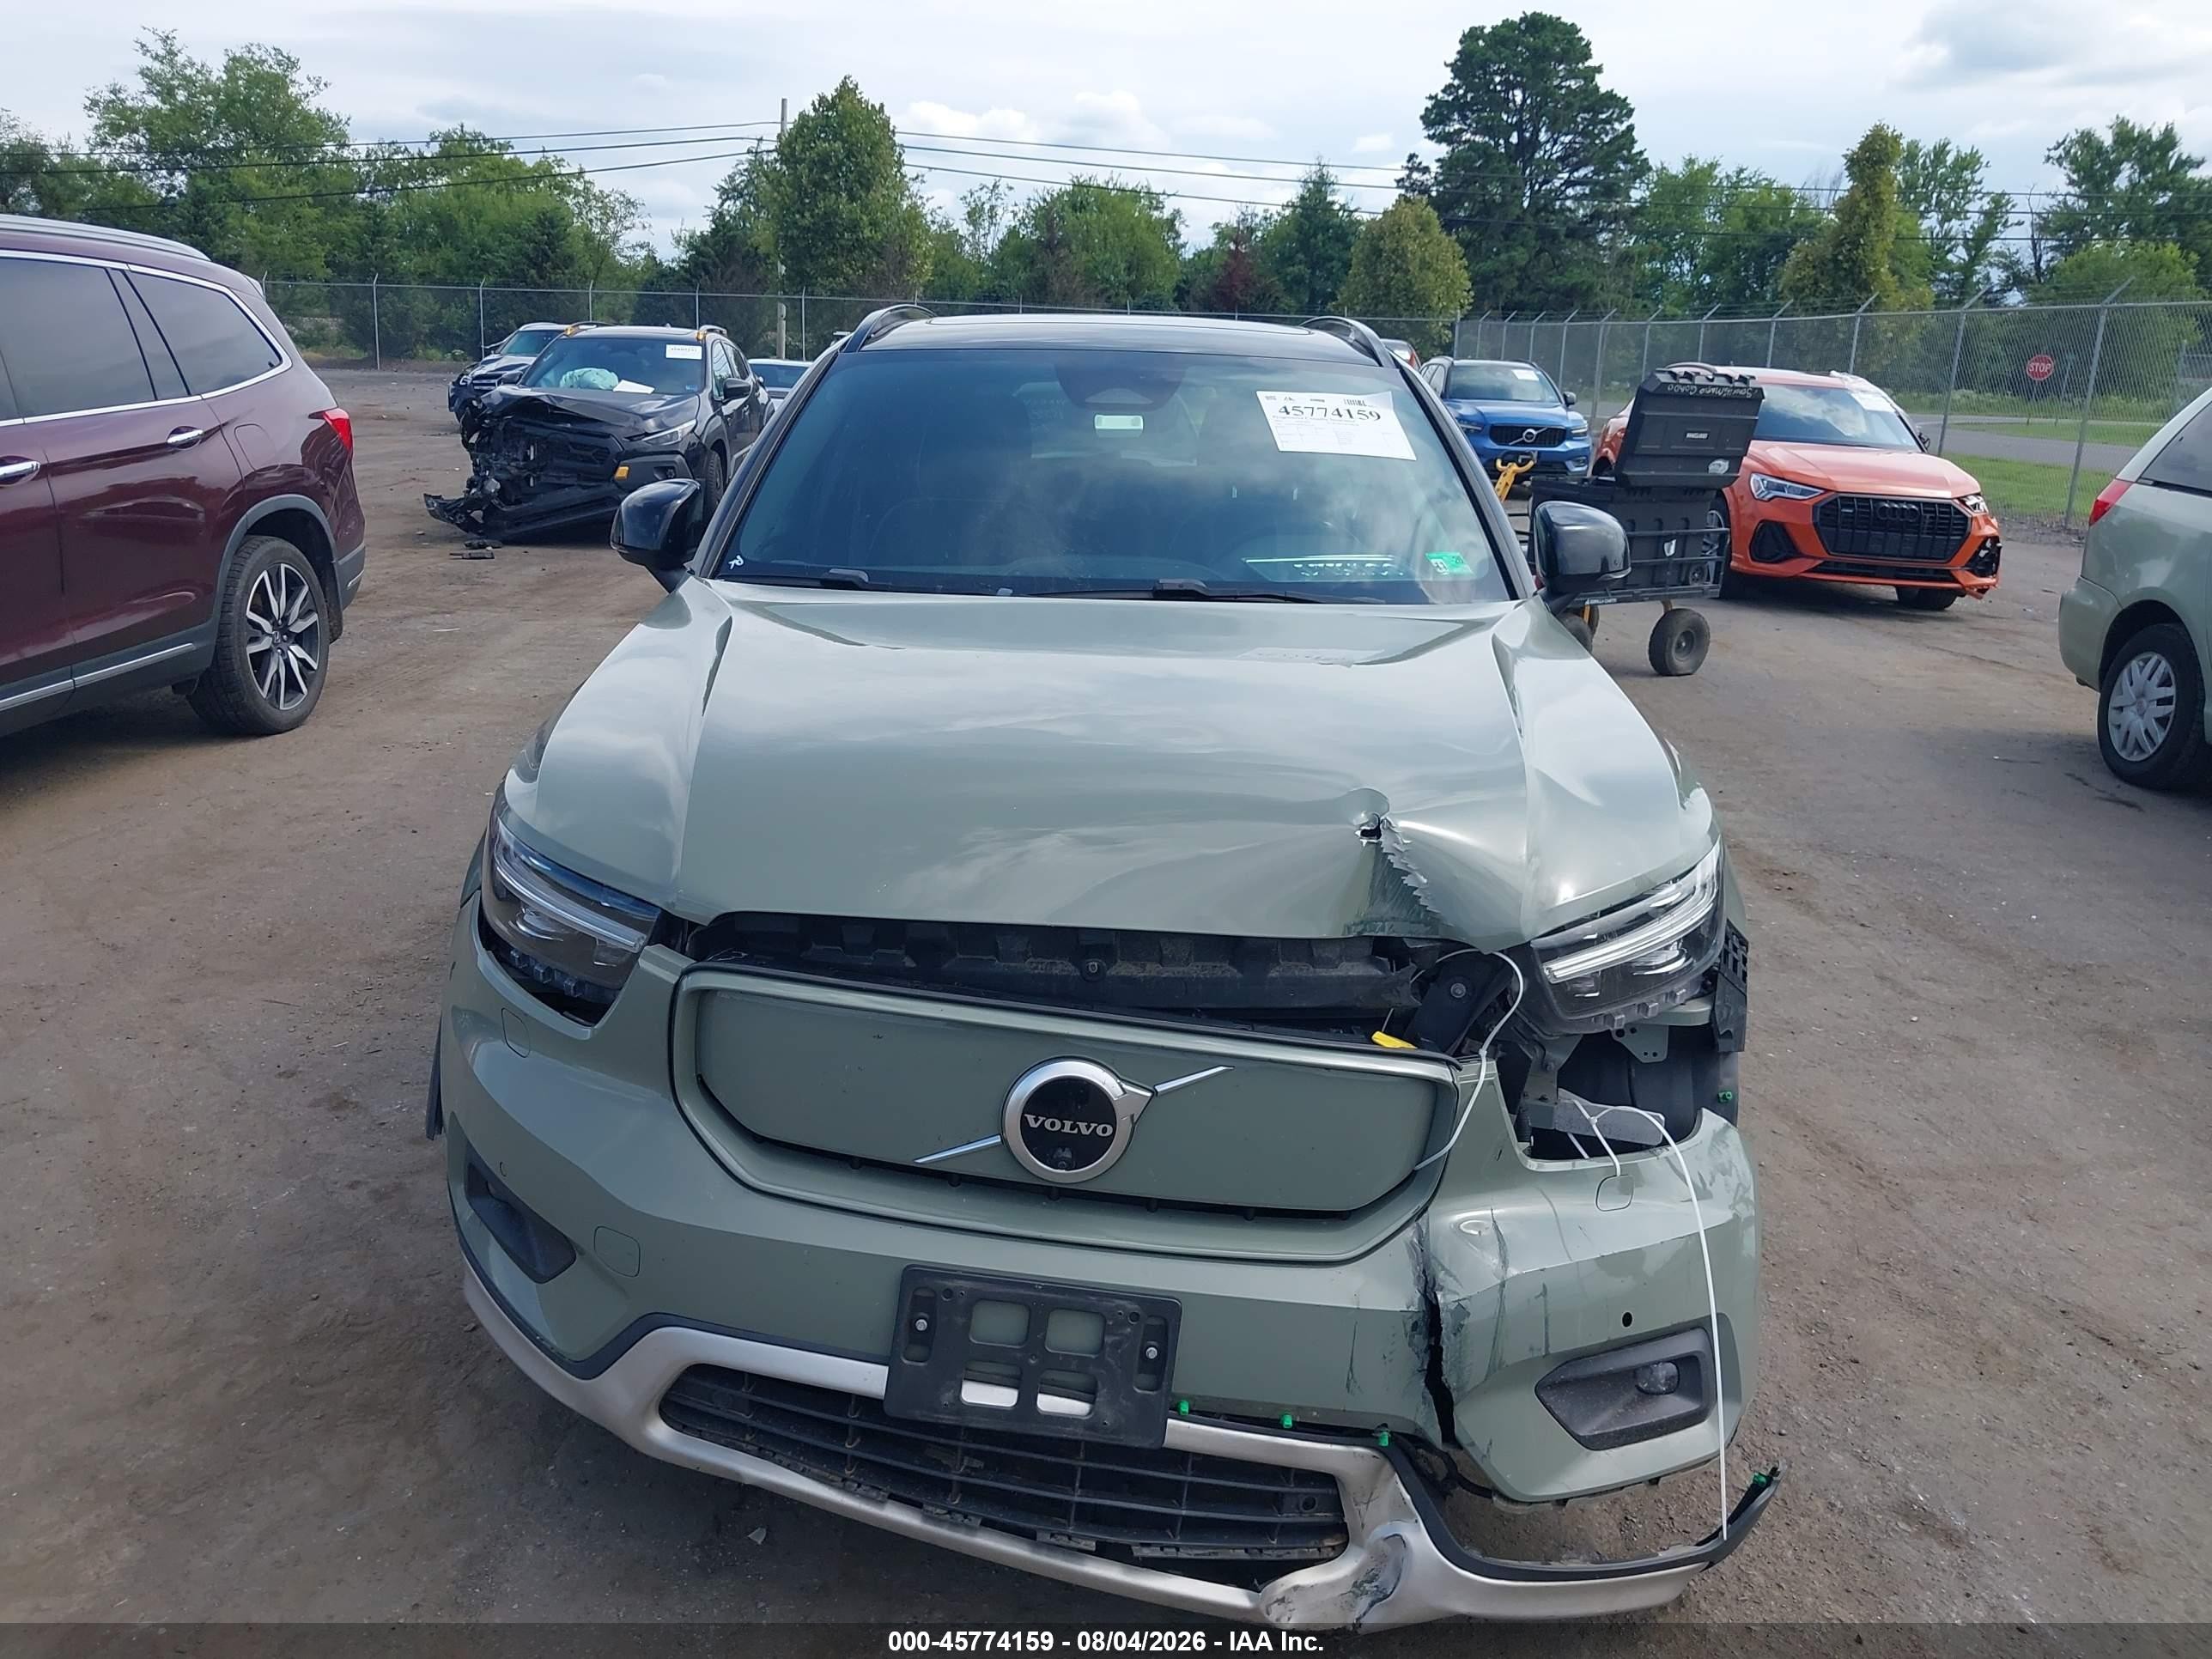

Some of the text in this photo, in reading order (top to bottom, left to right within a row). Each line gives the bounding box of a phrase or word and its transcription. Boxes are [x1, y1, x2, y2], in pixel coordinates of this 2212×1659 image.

[2029, 362, 2051, 372] STOP
[1278, 404, 1382, 422] 45774159
[1024, 1114, 1114, 1137] VOLVO
